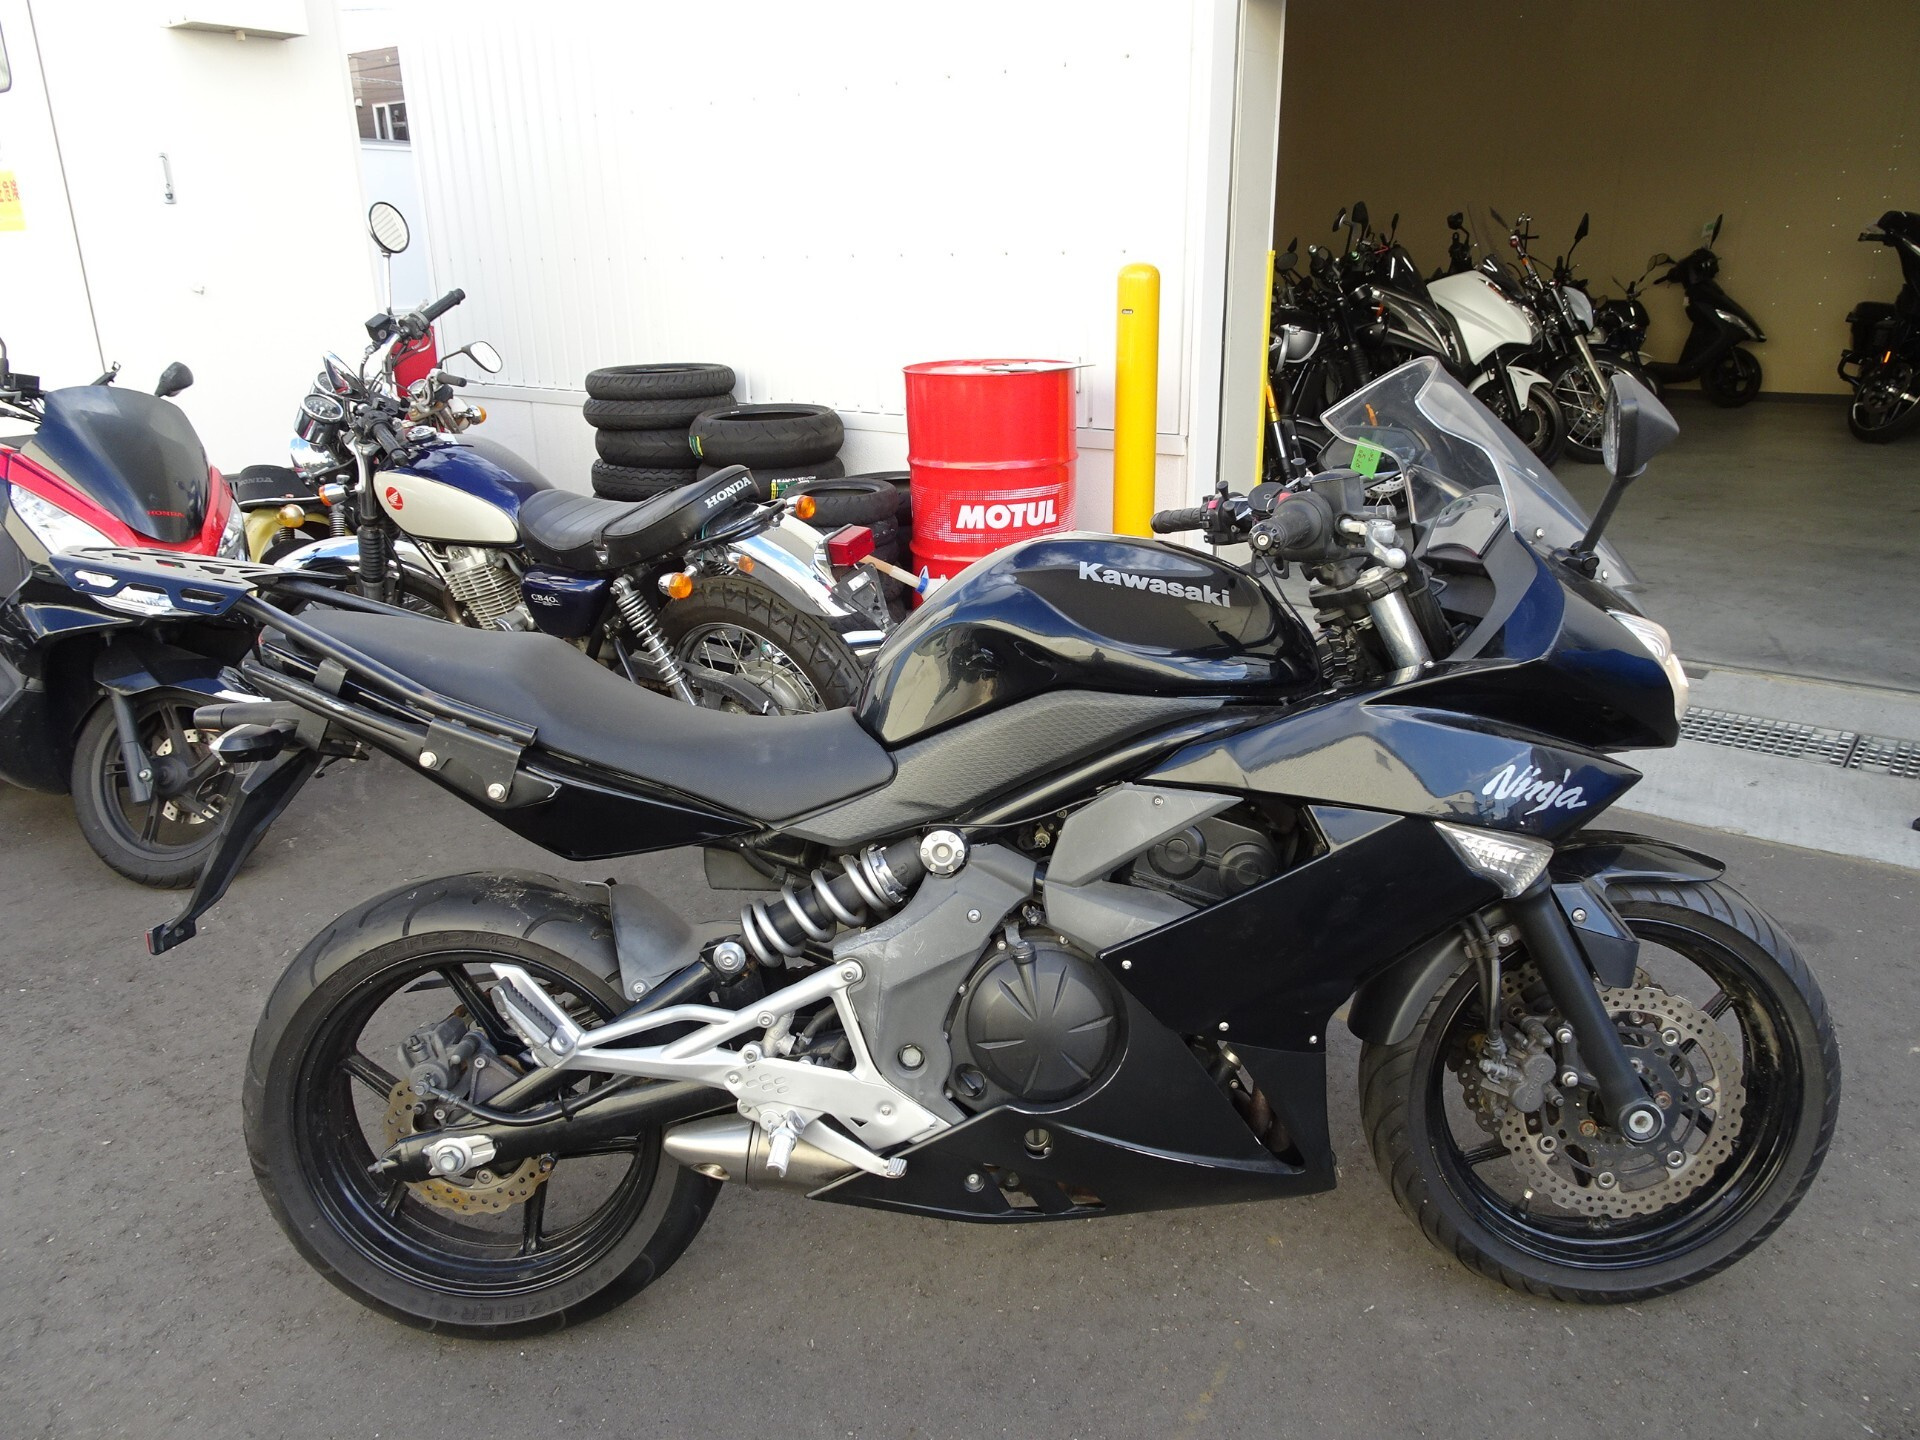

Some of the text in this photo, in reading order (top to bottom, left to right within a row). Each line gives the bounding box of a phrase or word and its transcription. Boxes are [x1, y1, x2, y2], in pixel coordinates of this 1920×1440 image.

[704, 476, 752, 509] HONDA
[956, 499, 1057, 529] MOTUL
[1079, 561, 1231, 608] Kawasaki
[1481, 764, 1588, 815] Ninja
[461, 1277, 596, 1321] METZELER
